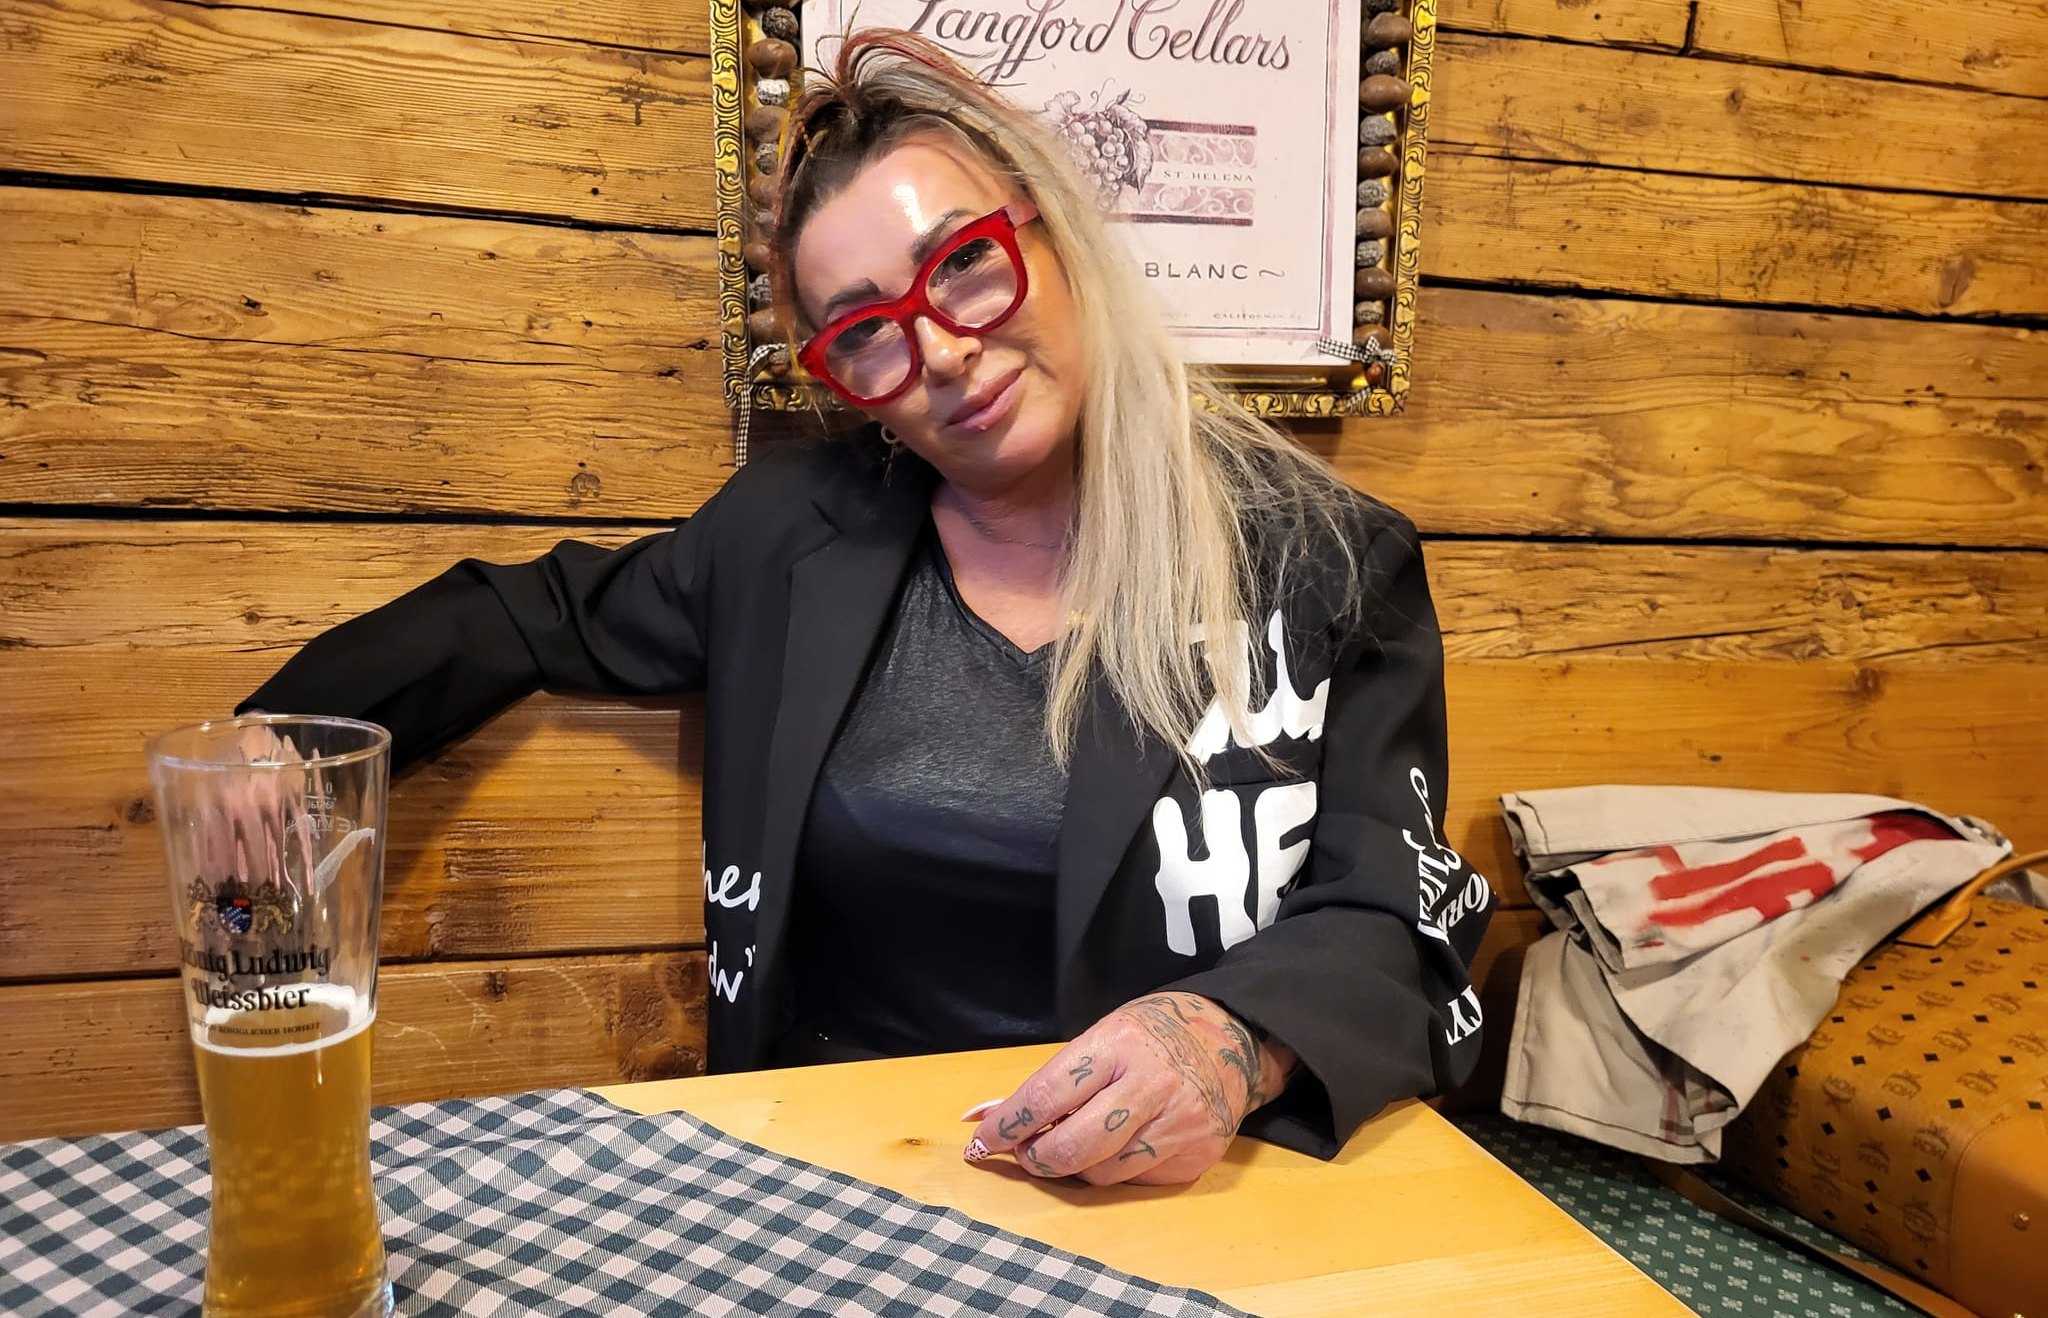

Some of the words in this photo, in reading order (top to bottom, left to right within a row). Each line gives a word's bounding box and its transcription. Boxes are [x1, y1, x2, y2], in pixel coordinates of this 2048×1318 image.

[1127, 0, 1291, 71] Cellars
[1192, 172, 1254, 182] HELENA
[1144, 261, 1249, 280] BLANC
[230, 944, 331, 984] Ludwig
